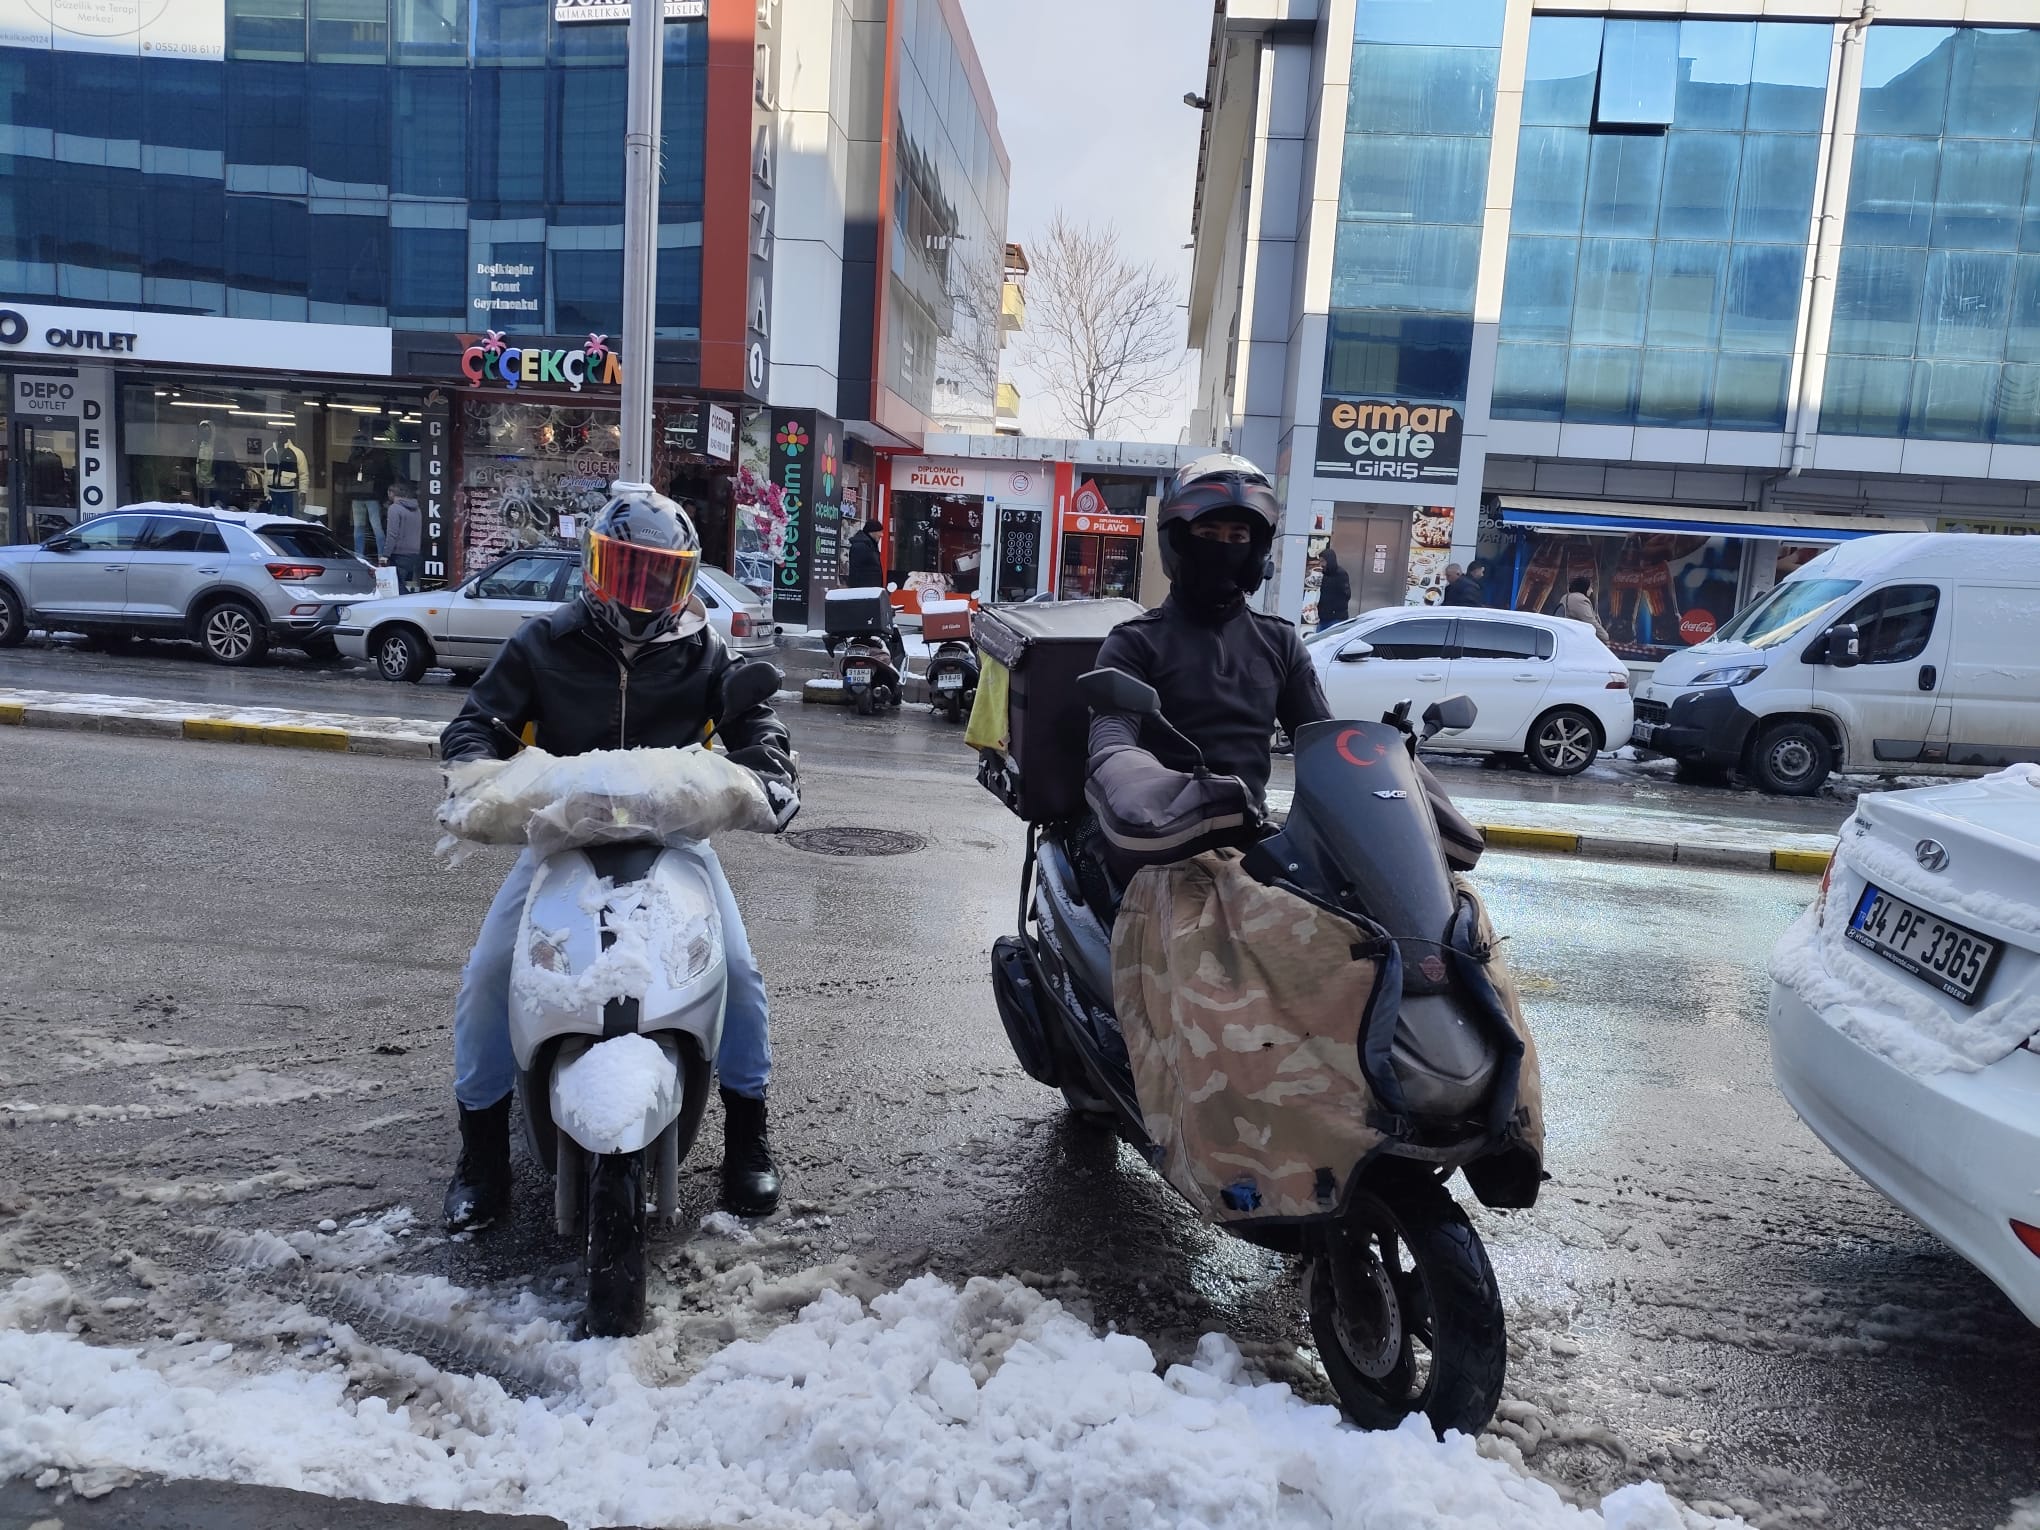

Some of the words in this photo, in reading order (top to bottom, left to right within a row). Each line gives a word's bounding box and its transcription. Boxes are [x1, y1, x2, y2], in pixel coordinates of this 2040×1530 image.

[55, 0, 92, 11] Güzellik
[95, 4, 106, 12] ve
[109, 3, 137, 15] Terapi
[77, 13, 114, 24] Merkezi
[155, 41, 179, 53] 0552
[181, 43, 198, 53] 018
[200, 45, 209, 54] 61
[211, 45, 221, 55] 17
[476, 263, 535, 278] Beşiktaşlar
[490, 280, 521, 293] Konut
[473, 297, 539, 312] Gayrimenkul
[45, 327, 138, 352] OUTLET
[20, 381, 75, 400] DEPO
[28, 399, 67, 411] OUTLET
[1331, 403, 1454, 433] ermar
[1343, 425, 1436, 459] cafe
[82, 399, 104, 506] DEPO
[1354, 459, 1419, 480] GİRİŞ
[1863, 896, 1892, 938] 34
[1889, 909, 1927, 951] PF
[1920, 925, 1988, 988] 3365
